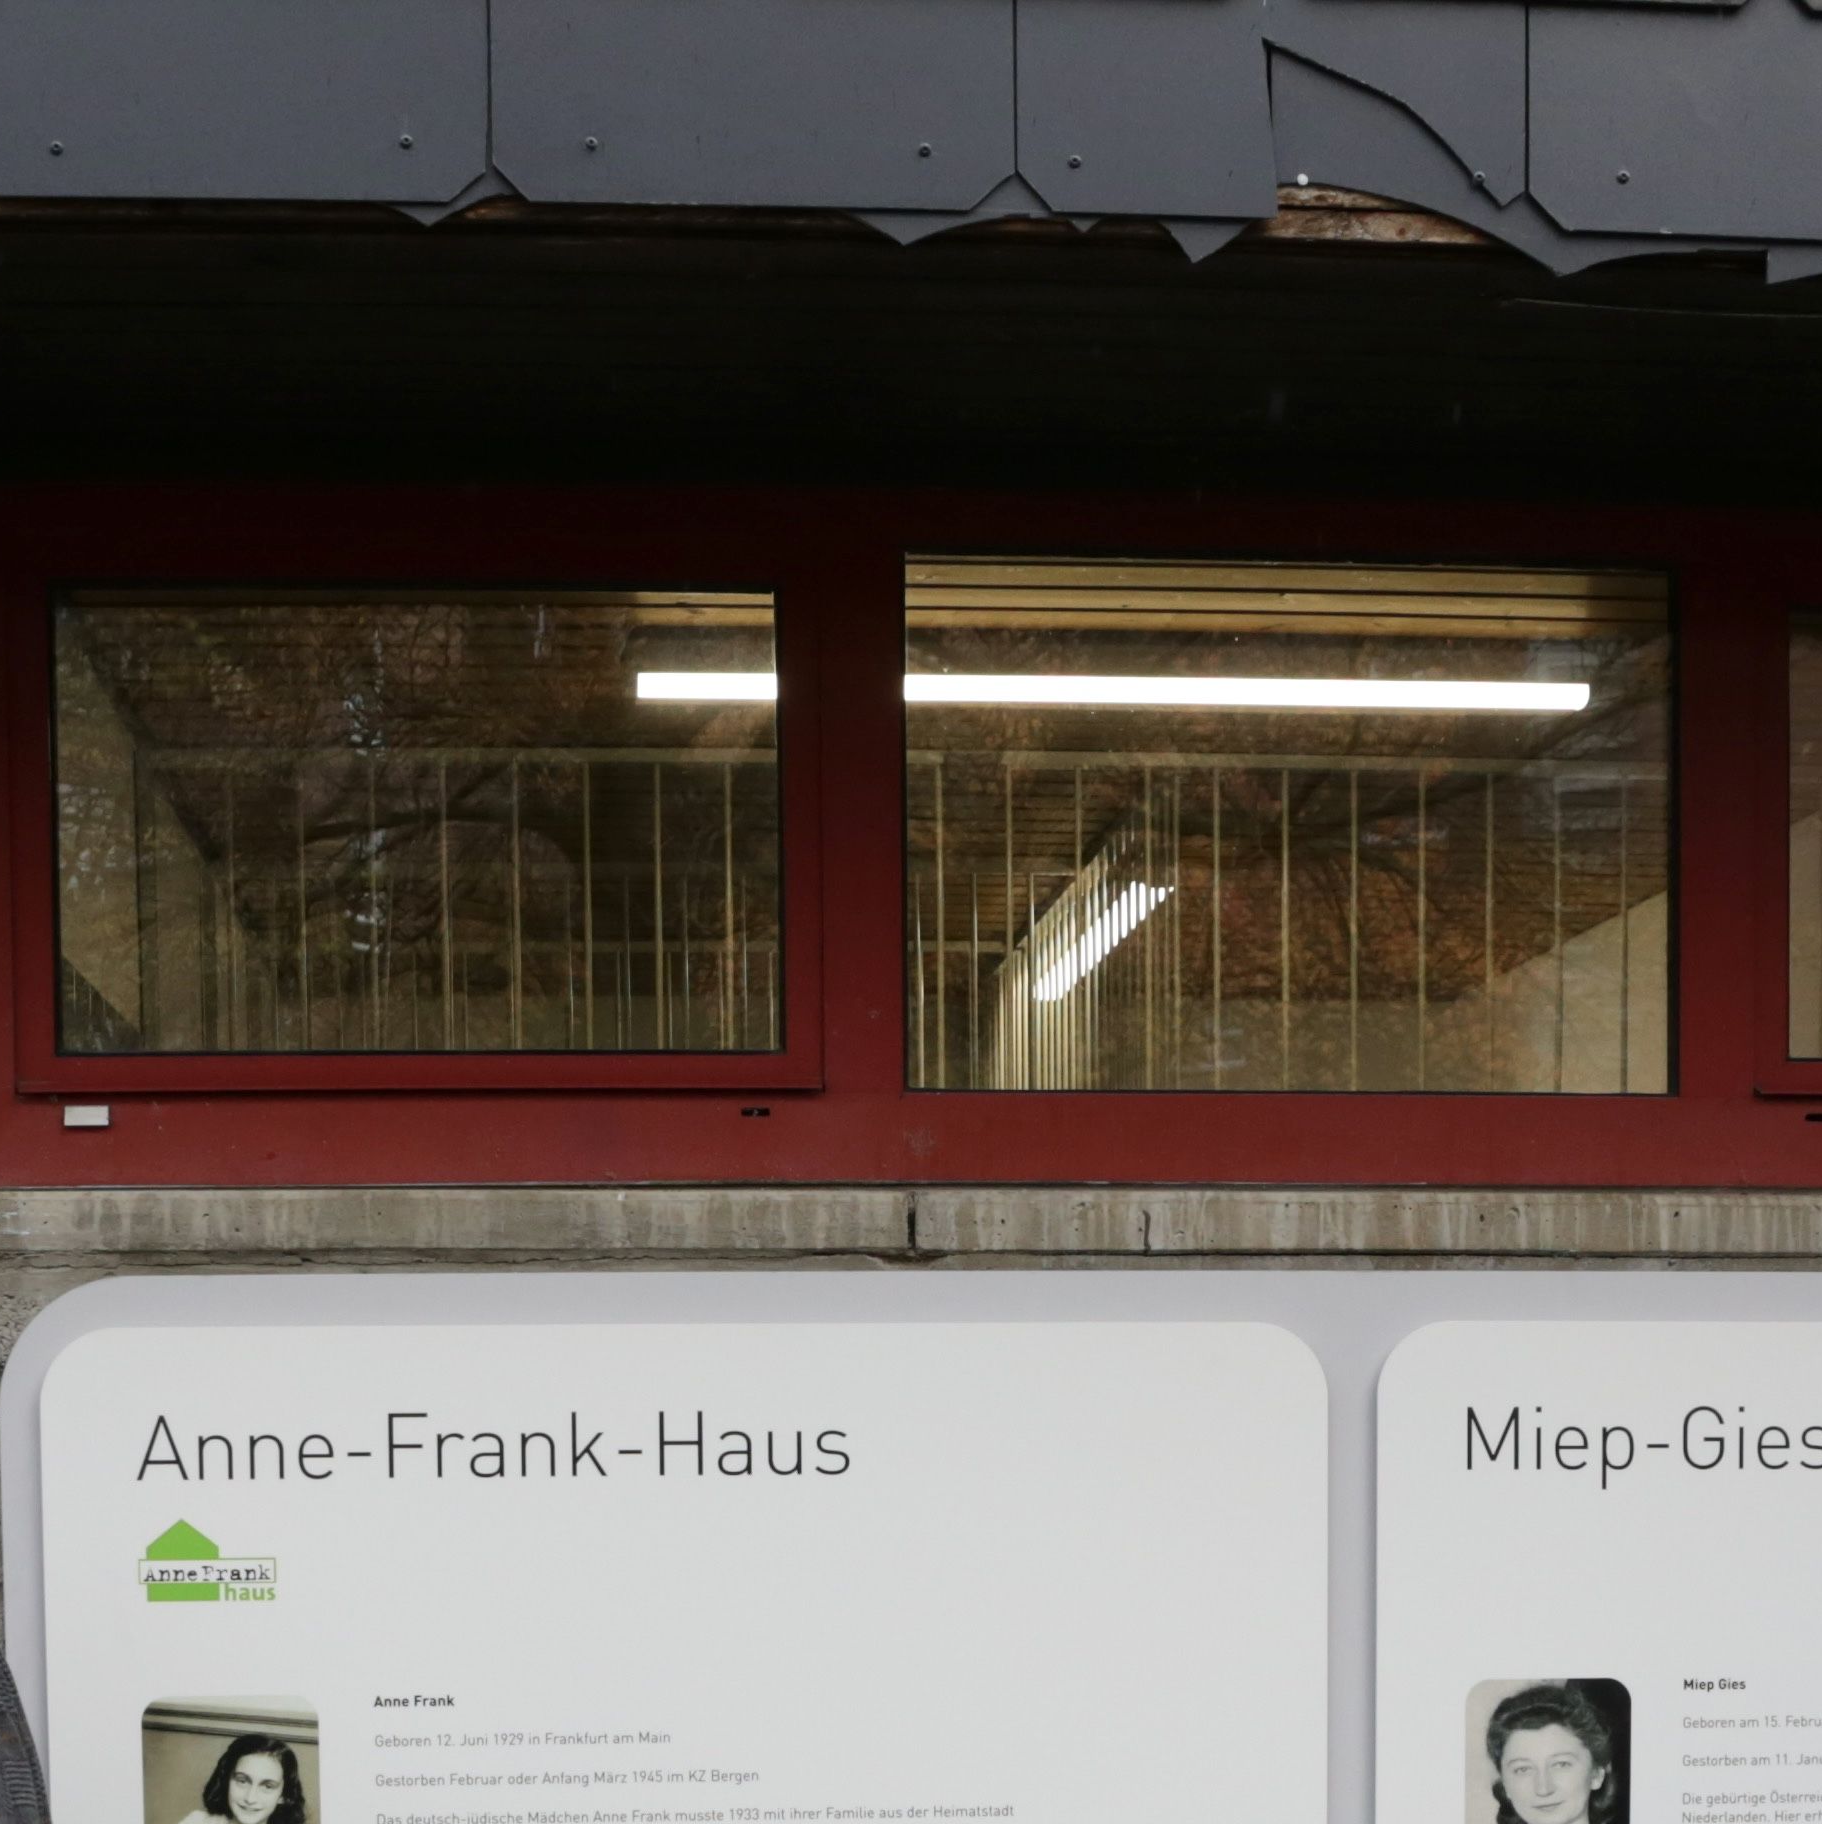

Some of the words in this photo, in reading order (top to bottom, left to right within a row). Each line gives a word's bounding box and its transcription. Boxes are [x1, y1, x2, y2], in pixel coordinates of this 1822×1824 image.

[136, 1410, 851, 1481] Anne-Frank-Haus
[224, 1584, 276, 1602] haus
[1682, 1678, 1714, 1692] Miep
[1717, 1678, 1746, 1690] Gies
[373, 1695, 410, 1708] Anne
[413, 1694, 455, 1707] Frank
[1682, 1715, 1736, 1729] Geboren
[1737, 1718, 1760, 1729] am
[1764, 1714, 1781, 1728] 15.
[373, 1733, 432, 1748] Geboren
[436, 1732, 456, 1747] 12.
[458, 1733, 488, 1747] Juni
[492, 1732, 524, 1746] 1929
[527, 1732, 541, 1745] in
[544, 1731, 608, 1745] Frankfurt
[611, 1733, 634, 1745] am
[638, 1730, 671, 1744] Main
[1681, 1753, 1748, 1767] Gestorben
[1749, 1755, 1771, 1767] am
[1774, 1752, 1792, 1766] 11.
[374, 1773, 446, 1787] Gestorben
[448, 1772, 504, 1786] Februar
[506, 1772, 538, 1785] oder
[541, 1771, 590, 1788] Anfang
[593, 1770, 628, 1784] März
[631, 1769, 663, 1783] 1945
[666, 1769, 684, 1783] im
[687, 1768, 707, 1783] KZ
[709, 1768, 759, 1786] Bergen
[1681, 1791, 1703, 1806] Die
[1705, 1791, 1767, 1808] gebürtige
[526, 1810, 589, 1824] Mädchen
[592, 1809, 628, 1823] Anne
[631, 1808, 671, 1823] Frank
[674, 1809, 724, 1822] musste
[728, 1807, 760, 1821] 1933
[762, 1807, 786, 1821] mit
[788, 1807, 822, 1820] ihrer
[825, 1805, 875, 1820] Familie
[878, 1808, 903, 1819] aus
[905, 1805, 930, 1819] der
[932, 1804, 1014, 1818] Heimatstadt
